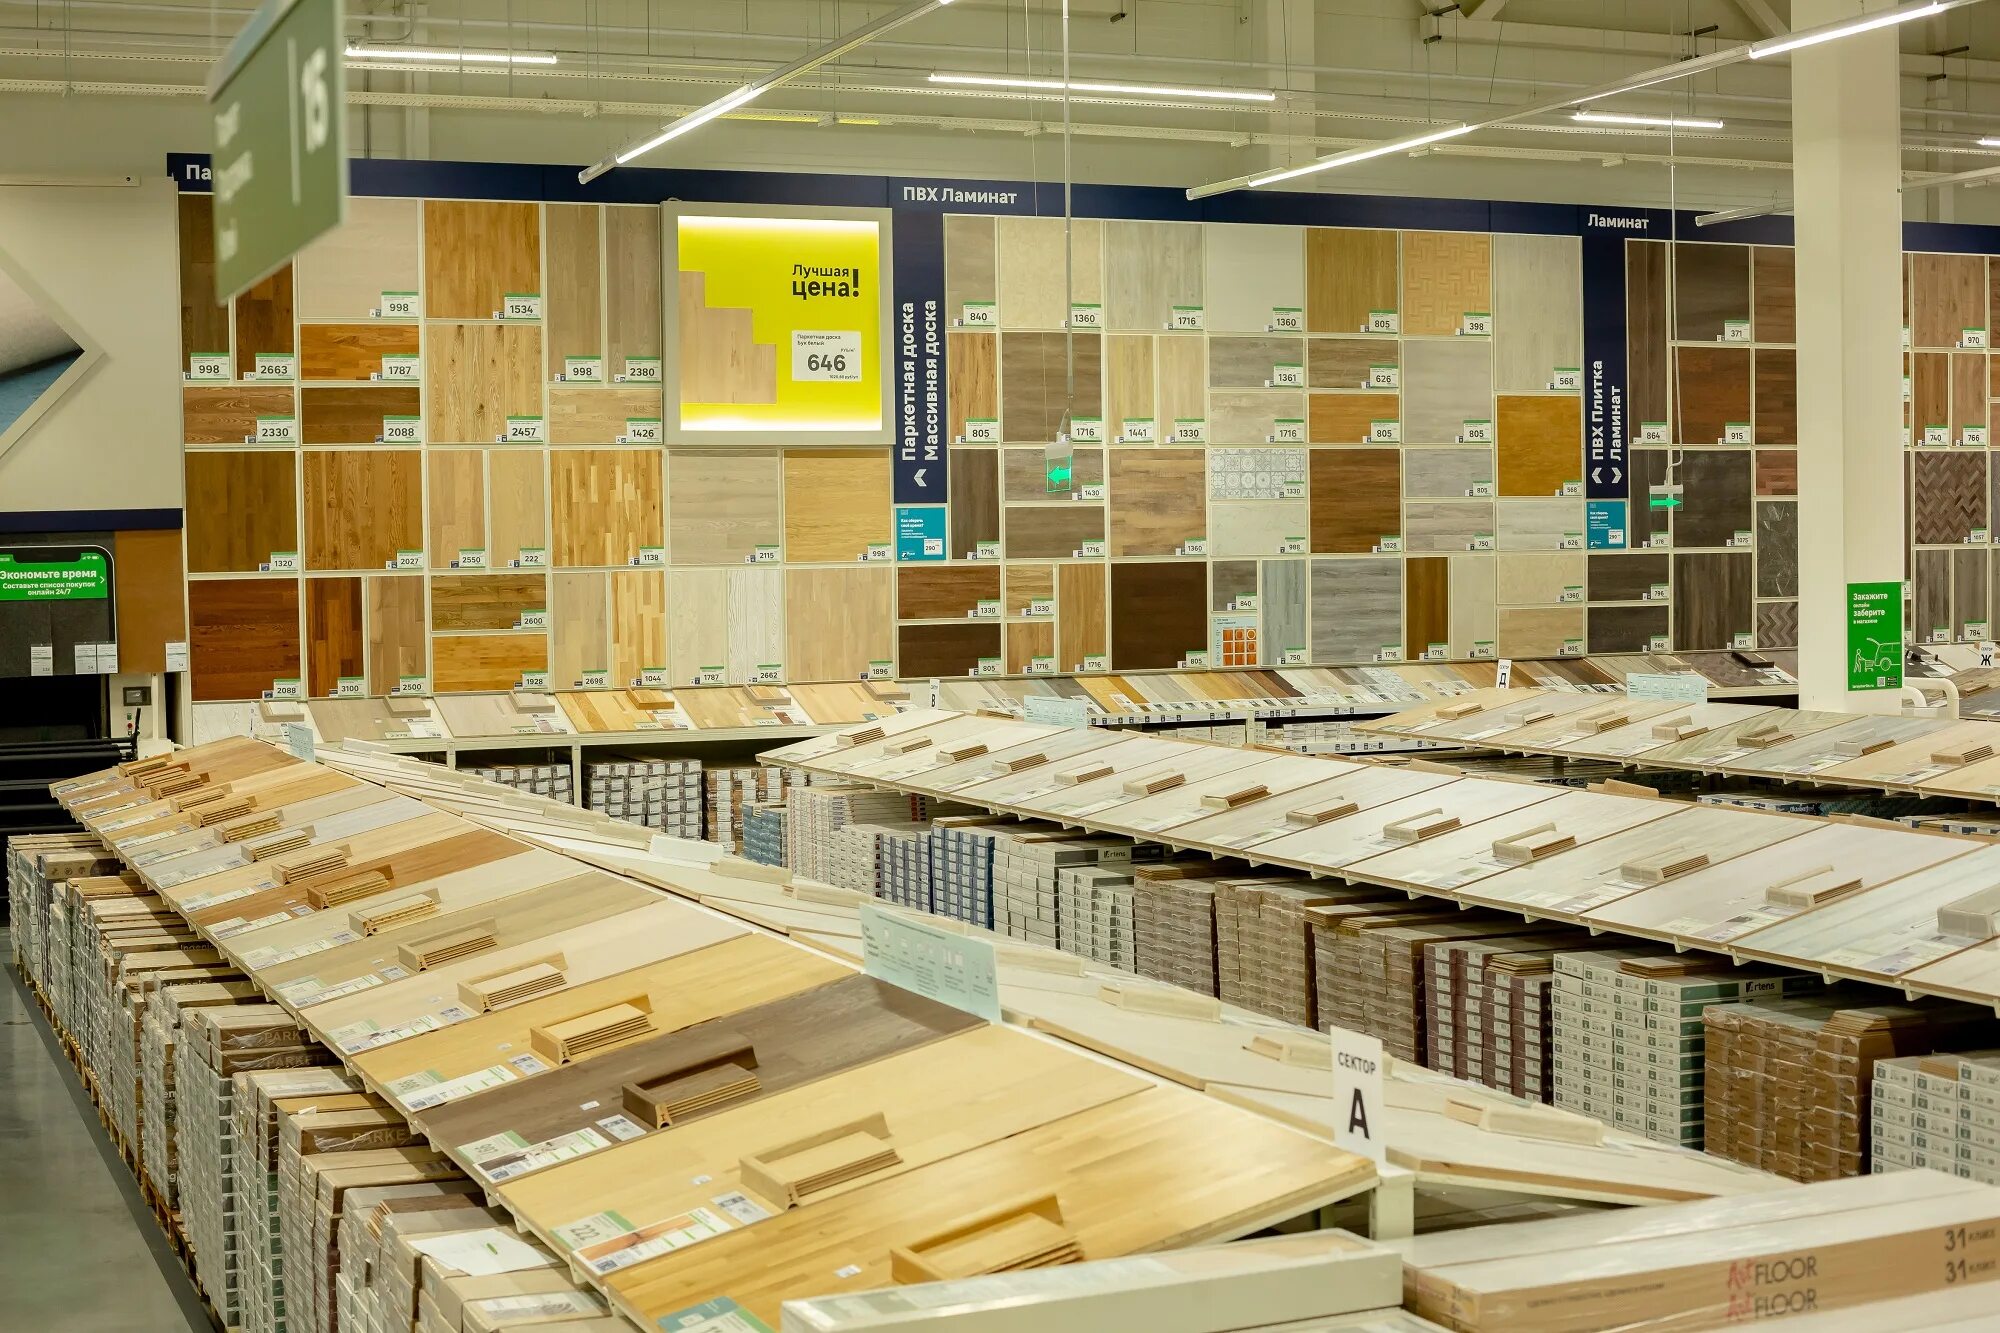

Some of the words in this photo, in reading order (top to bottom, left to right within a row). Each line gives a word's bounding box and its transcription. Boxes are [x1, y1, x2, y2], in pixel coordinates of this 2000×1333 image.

[186, 164, 212, 180] Па
[903, 187, 938, 202] ПВХ
[941, 188, 1018, 204] Ламинат
[1588, 214, 1649, 229] Ламинат
[792, 265, 849, 278] Лучшая
[792, 269, 859, 300] цена!
[390, 303, 409, 312] 998
[510, 305, 533, 314] 1534
[1178, 317, 1195, 325] 1716
[1277, 318, 1296, 326] 1360
[1374, 320, 1390, 328] 805
[902, 302, 917, 357] доска
[925, 300, 939, 355] доска
[1470, 322, 1484, 330] 398
[808, 354, 846, 371] 646
[199, 365, 220, 375] 998
[260, 365, 288, 375] 2663
[389, 366, 411, 375] 1787
[573, 367, 592, 376] 998
[630, 368, 654, 376] 2380
[1278, 374, 1296, 382] 1361
[1376, 375, 1391, 383] 626
[1560, 377, 1573, 385] 568
[1592, 360, 1604, 423] Плитка
[902, 361, 919, 461] Паркетная
[924, 358, 938, 461] Массивная
[1610, 386, 1621, 461] Ламинат
[262, 428, 289, 437] 2330
[388, 428, 414, 437] 2088
[512, 428, 536, 436] 2457
[632, 429, 654, 437] 1426
[1076, 428, 1094, 436] 1716
[1129, 429, 1147, 437] 1441
[1179, 429, 1199, 437] 1330
[1279, 429, 1297, 437] 1716
[1377, 429, 1392, 437] 805
[1469, 429, 1484, 437] 805
[1647, 432, 1660, 440] 864
[1731, 432, 1743, 440] 915
[1592, 426, 1604, 460] ПВХ
[0, 571, 60, 579] Экономьте
[62, 570, 97, 580] время
[1853, 609, 1885, 617] заберите
[524, 617, 542, 625] 2600
[1981, 654, 1991, 666] Ж
[586, 677, 603, 685] 2698
[704, 673, 719, 681] 1787
[403, 683, 421, 691] 2500
[1338, 1052, 1376, 1076] СЕКТОР
[1945, 1228, 1966, 1251] 31
[1945, 1259, 1967, 1283] 31
